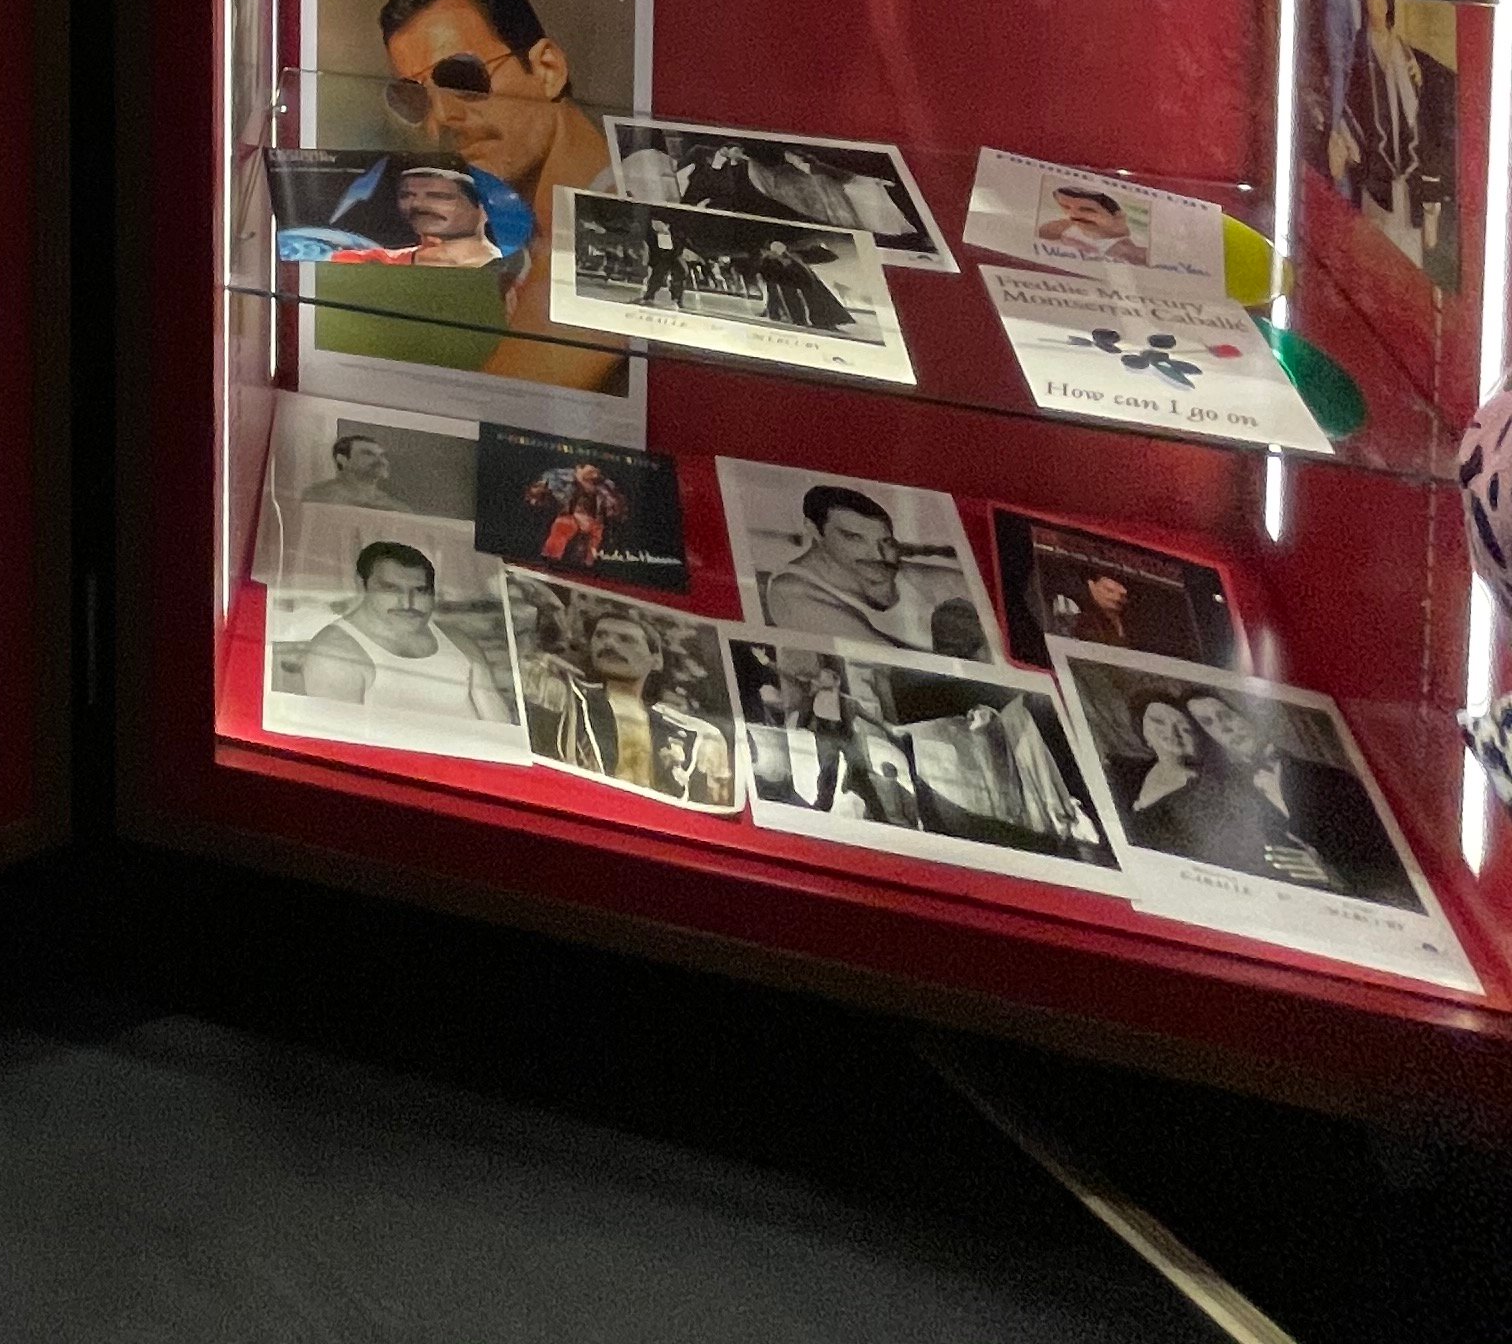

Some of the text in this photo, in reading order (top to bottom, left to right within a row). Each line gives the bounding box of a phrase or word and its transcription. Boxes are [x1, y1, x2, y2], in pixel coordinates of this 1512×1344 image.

[995, 273, 1204, 313] Freddie Mercury
[1001, 288, 1141, 318] Montserrat
[1046, 380, 1259, 428] How can I go on
